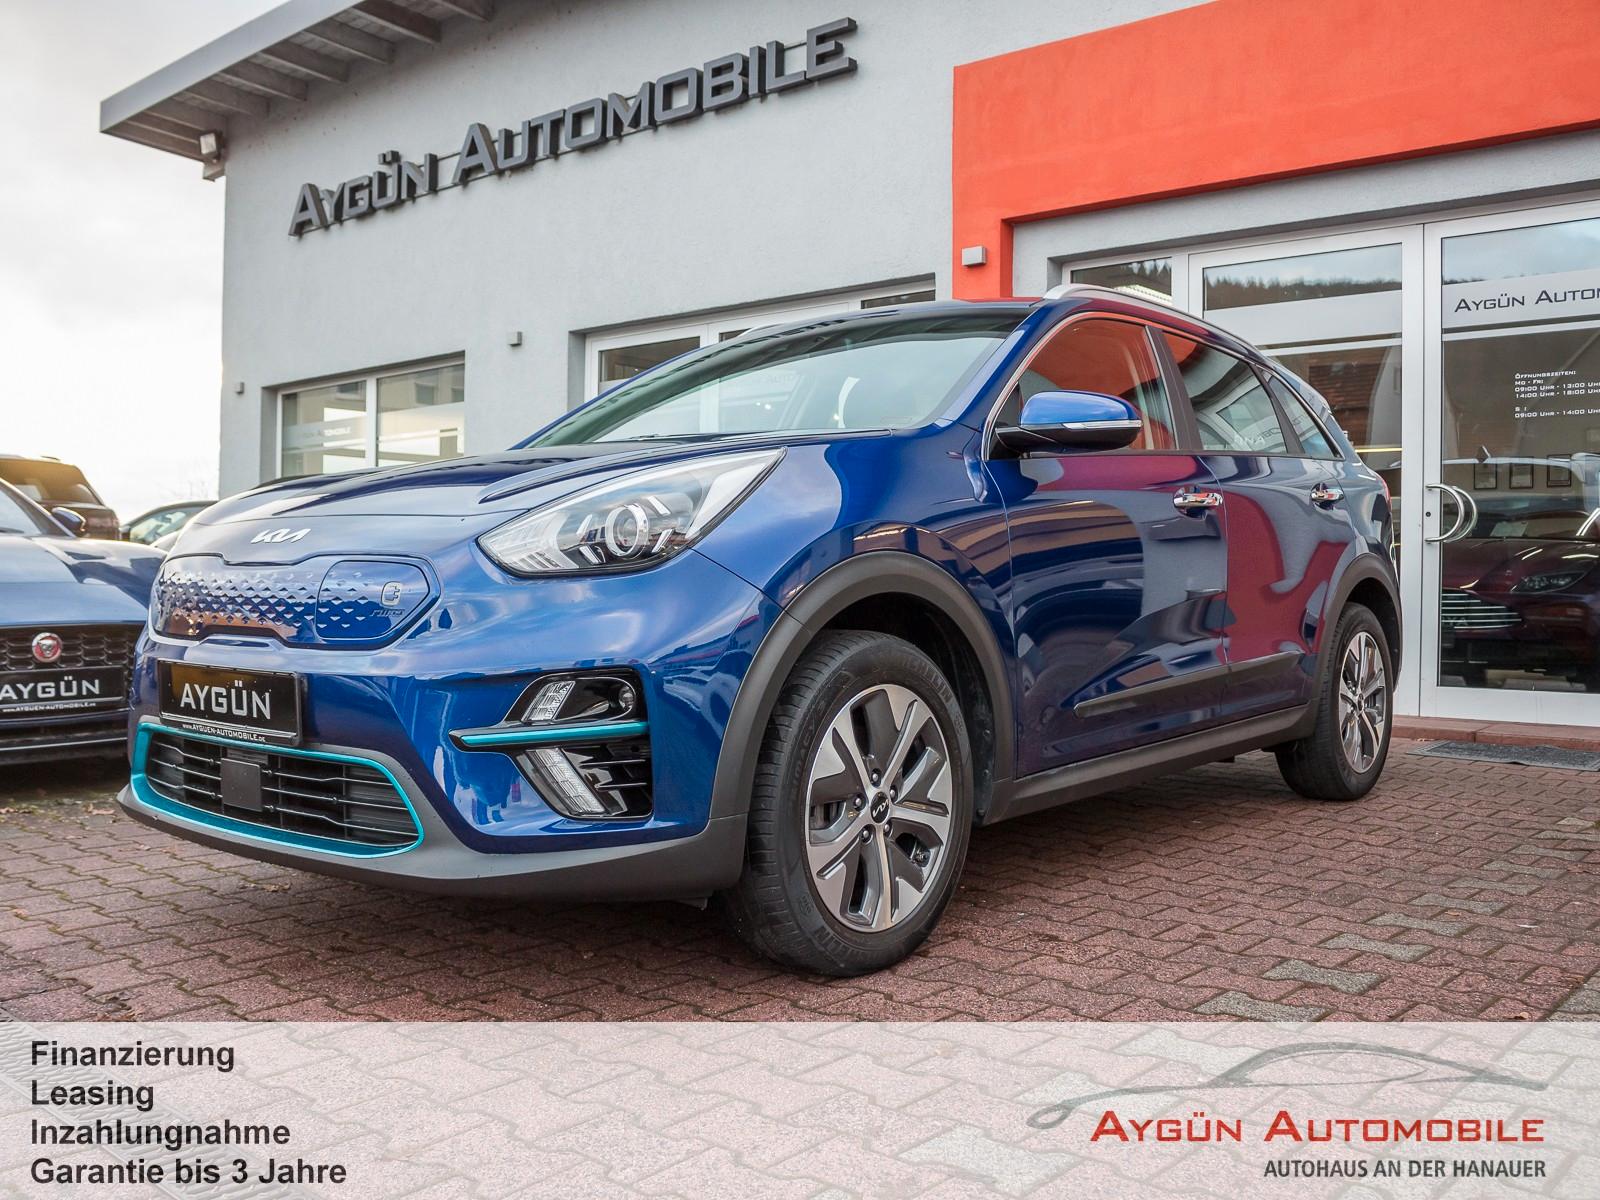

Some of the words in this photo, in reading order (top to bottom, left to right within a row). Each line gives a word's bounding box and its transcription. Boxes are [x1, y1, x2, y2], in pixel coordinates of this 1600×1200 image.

[288, 150, 438, 236] AYGÜN
[453, 17, 859, 185] AUTOMOBILE
[1454, 293, 1525, 312] AYGÜN
[1535, 288, 1600, 304] AUTO
[0, 676, 100, 700] AYGÜN
[180, 680, 272, 720] AYGÜN
